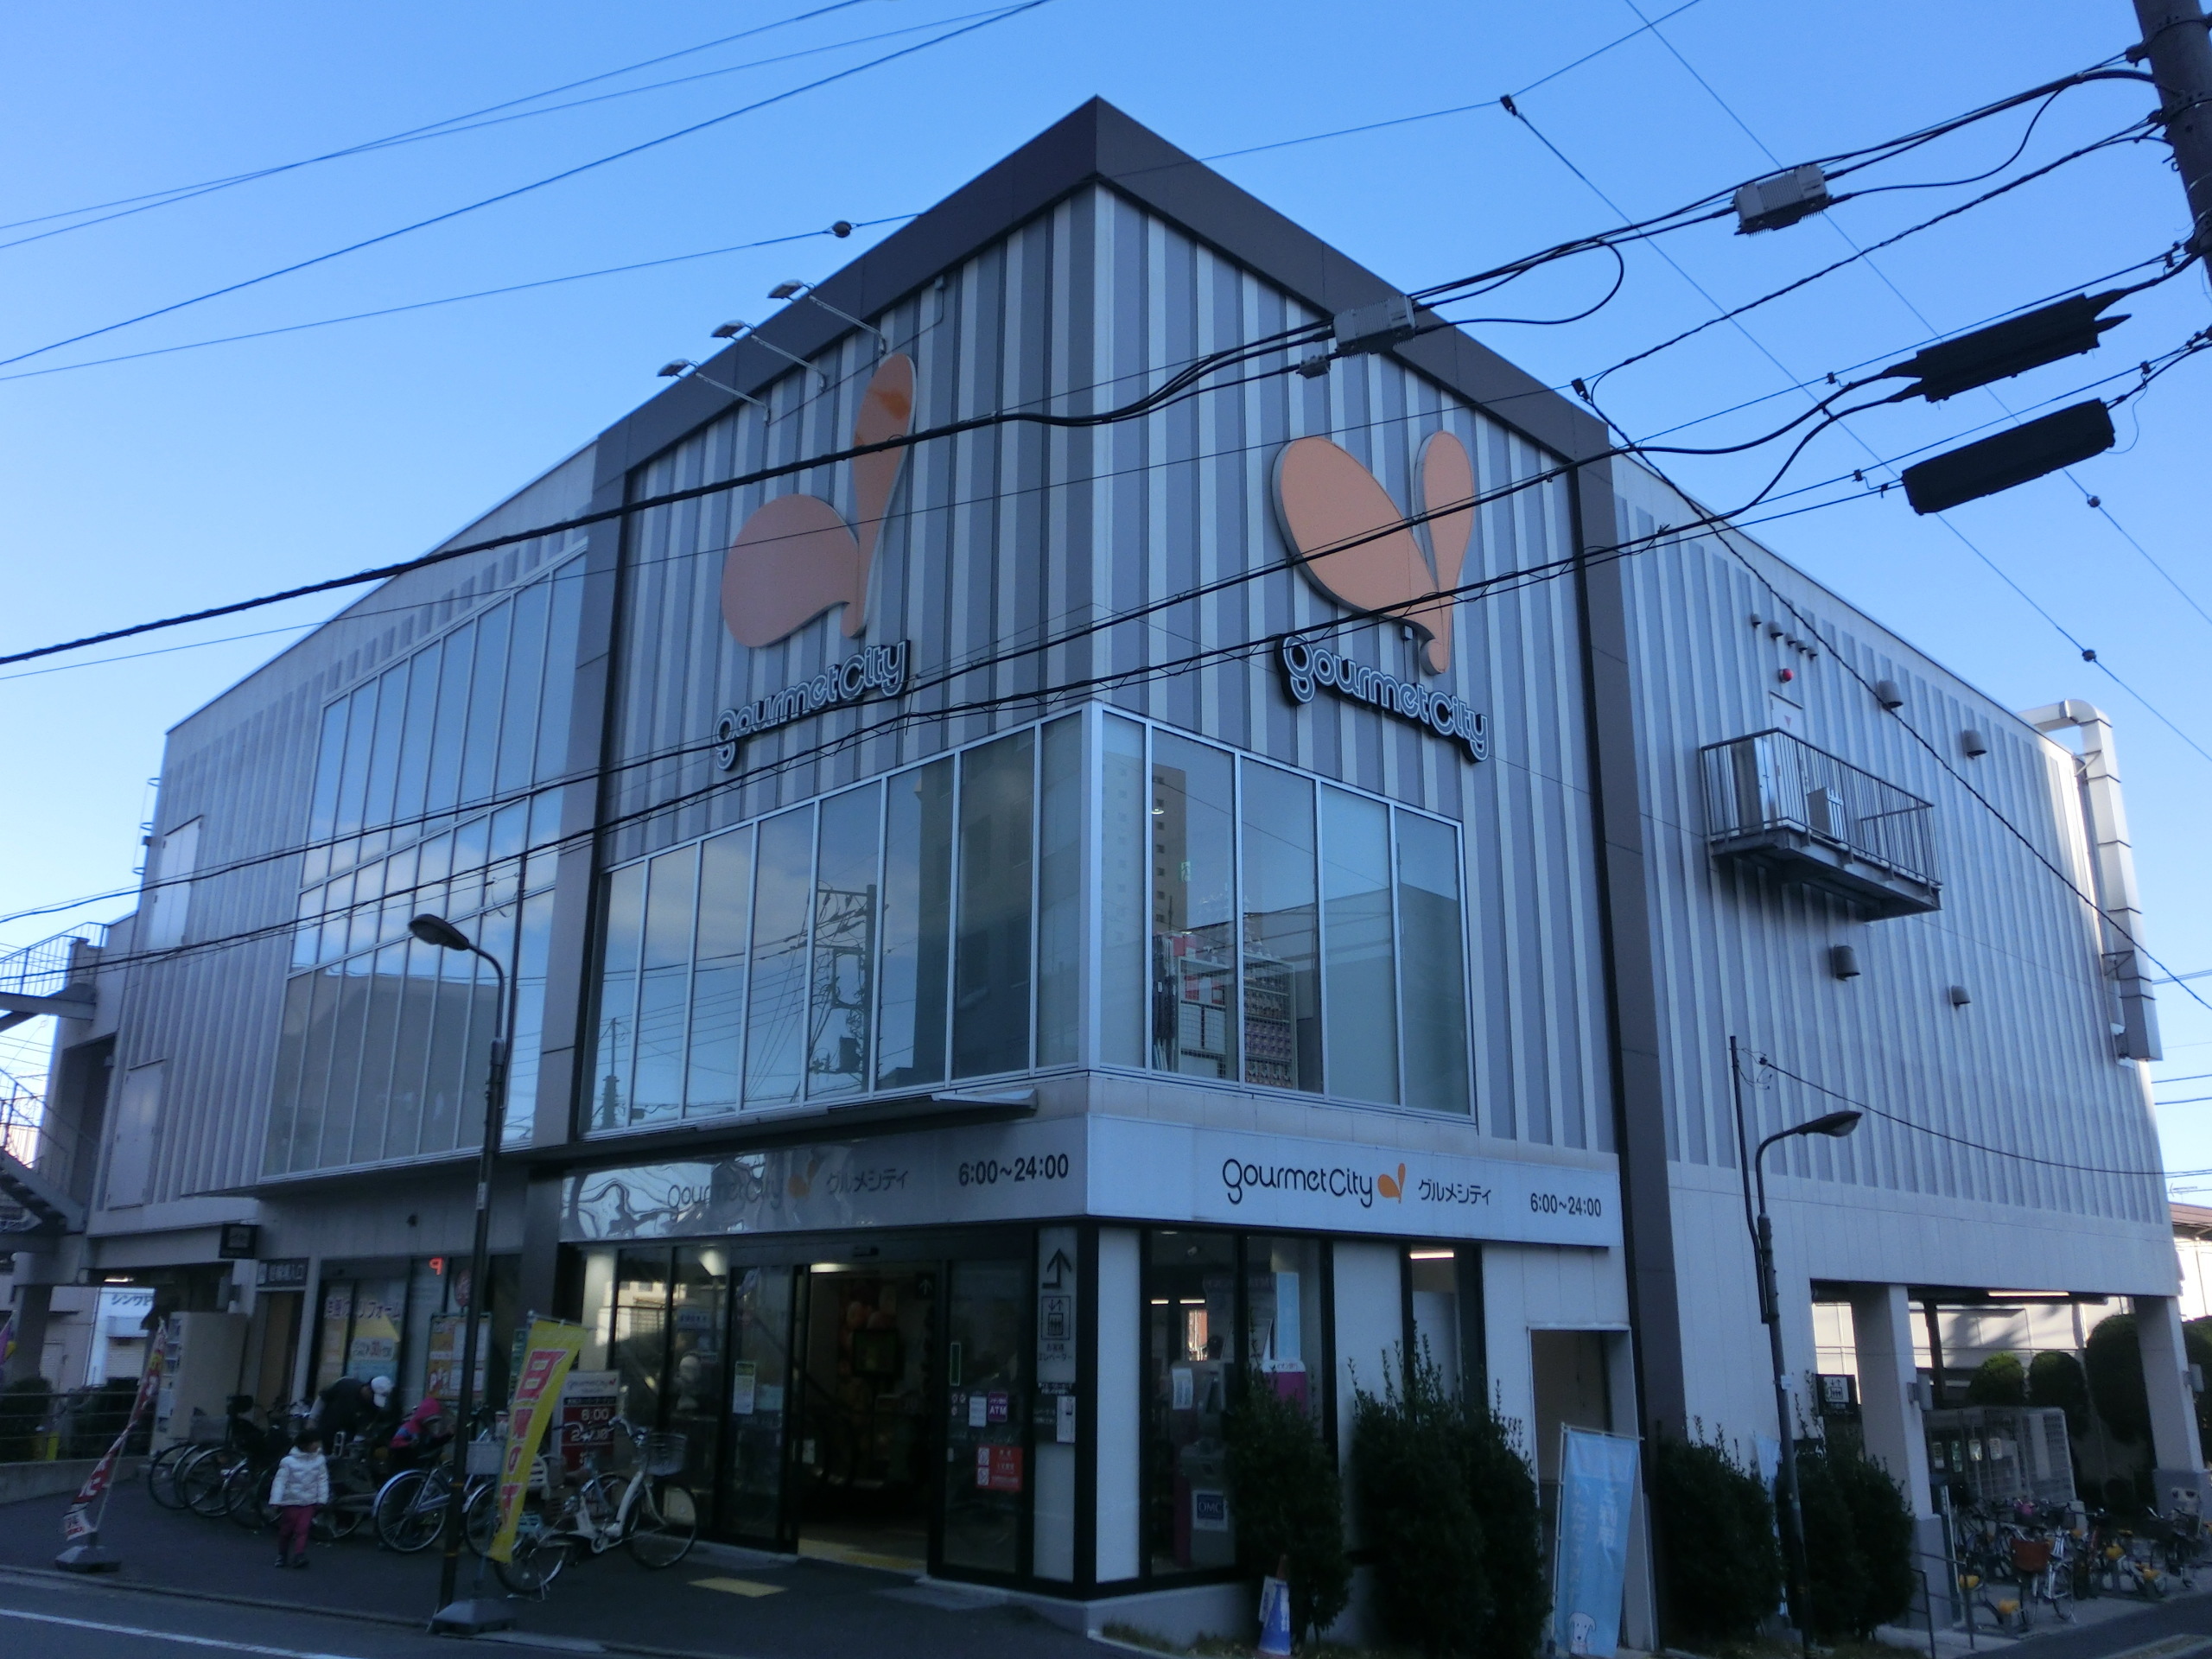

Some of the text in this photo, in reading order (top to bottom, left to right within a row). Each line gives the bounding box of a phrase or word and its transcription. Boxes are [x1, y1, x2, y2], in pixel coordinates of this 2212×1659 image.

[713, 639, 910, 771] gourmetCity
[1277, 633, 1489, 763] gourmetCity
[1222, 1159, 1373, 1208] gourmetCity
[1418, 1179, 1491, 1206] グルメシティ
[989, 1405, 1007, 1415] ATM
[1198, 1501, 1222, 1514] OMC
